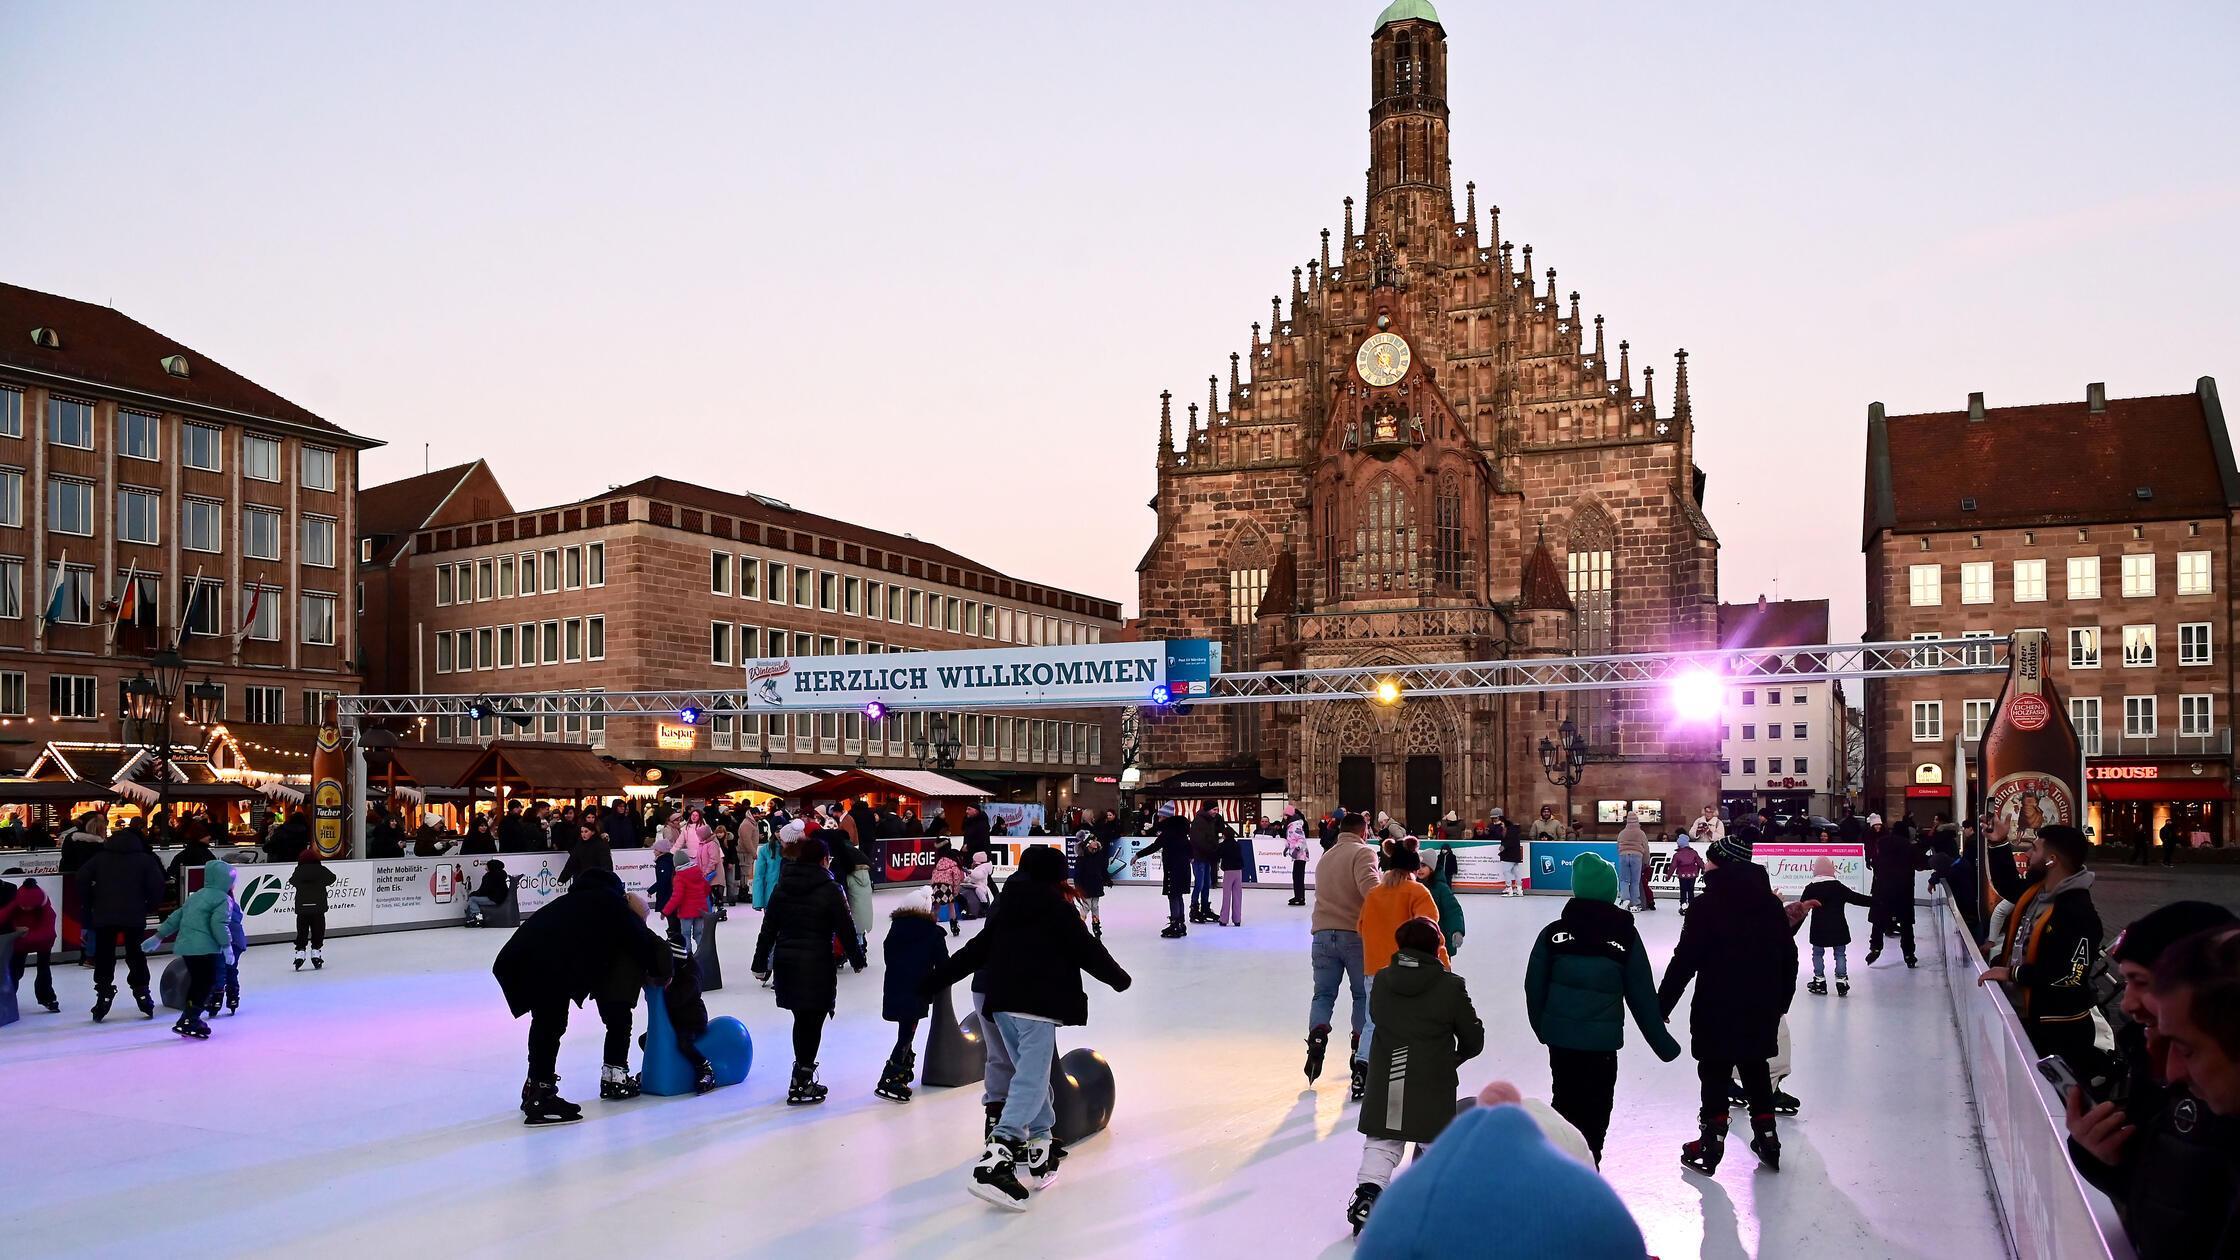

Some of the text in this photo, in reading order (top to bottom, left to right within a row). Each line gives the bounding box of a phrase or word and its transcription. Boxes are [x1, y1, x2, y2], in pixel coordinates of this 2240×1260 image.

[2019, 645, 2027, 677] Tucher
[2027, 641, 2037, 681] Rotbier
[794, 658, 1158, 693] HERZLICH WILLKOMMEN
[2096, 766, 2158, 779] HOUSE
[316, 807, 341, 817] Tucher
[320, 829, 336, 839] HELL
[376, 866, 393, 874] Mehr
[395, 864, 422, 873] Mobilität
[406, 874, 416, 882] auf
[392, 884, 403, 892] Eis.
